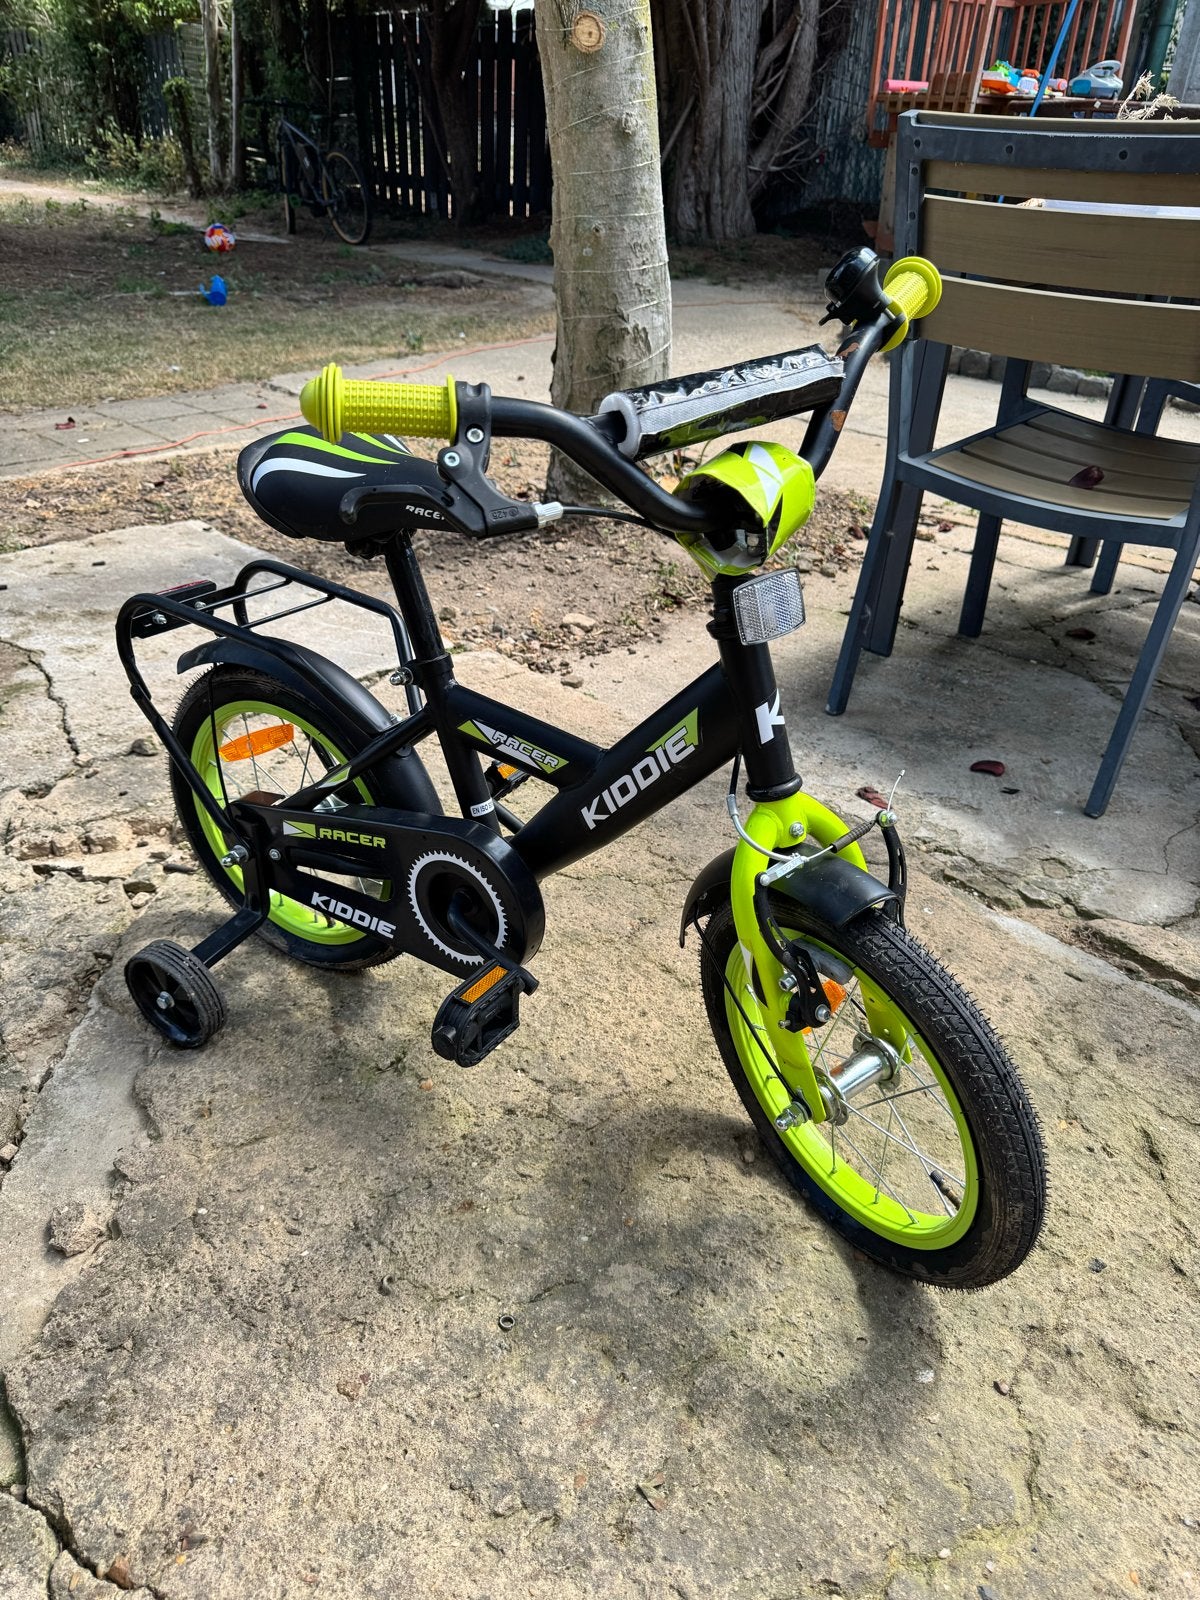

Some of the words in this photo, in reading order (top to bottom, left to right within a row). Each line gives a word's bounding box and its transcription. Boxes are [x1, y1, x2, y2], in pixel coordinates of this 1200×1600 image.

[405, 504, 445, 520] RACE
[491, 730, 560, 768] RACER
[580, 725, 696, 831] KIDDIE
[319, 827, 387, 849] RACER
[310, 891, 397, 940] KIDDIE
